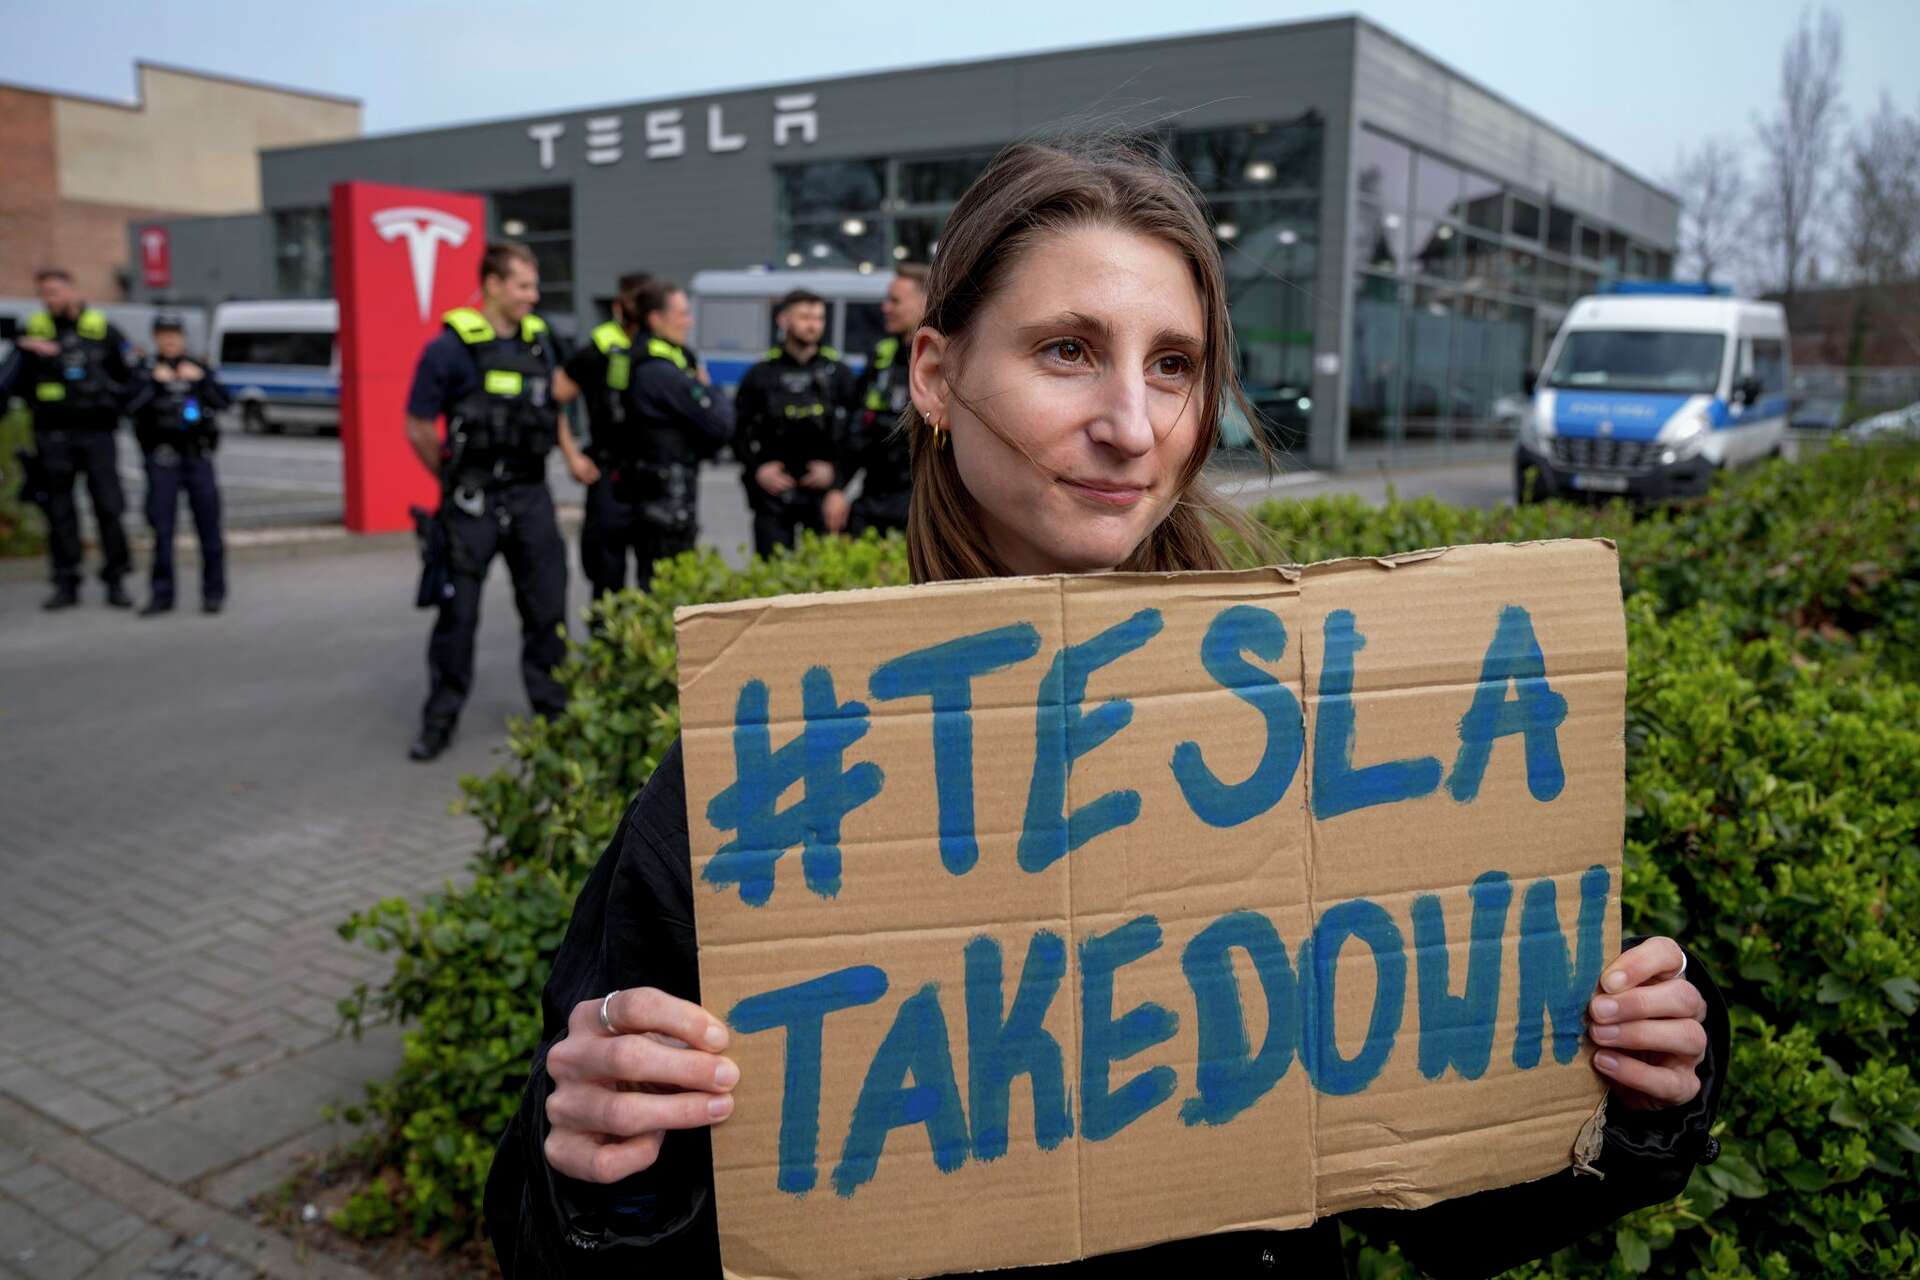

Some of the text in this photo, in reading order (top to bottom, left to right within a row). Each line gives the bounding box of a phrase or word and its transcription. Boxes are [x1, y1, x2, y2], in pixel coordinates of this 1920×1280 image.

[528, 93, 818, 169] TESLA
[702, 604, 1568, 907] #TESLA
[728, 865, 1611, 1198] TAKEDOWN
